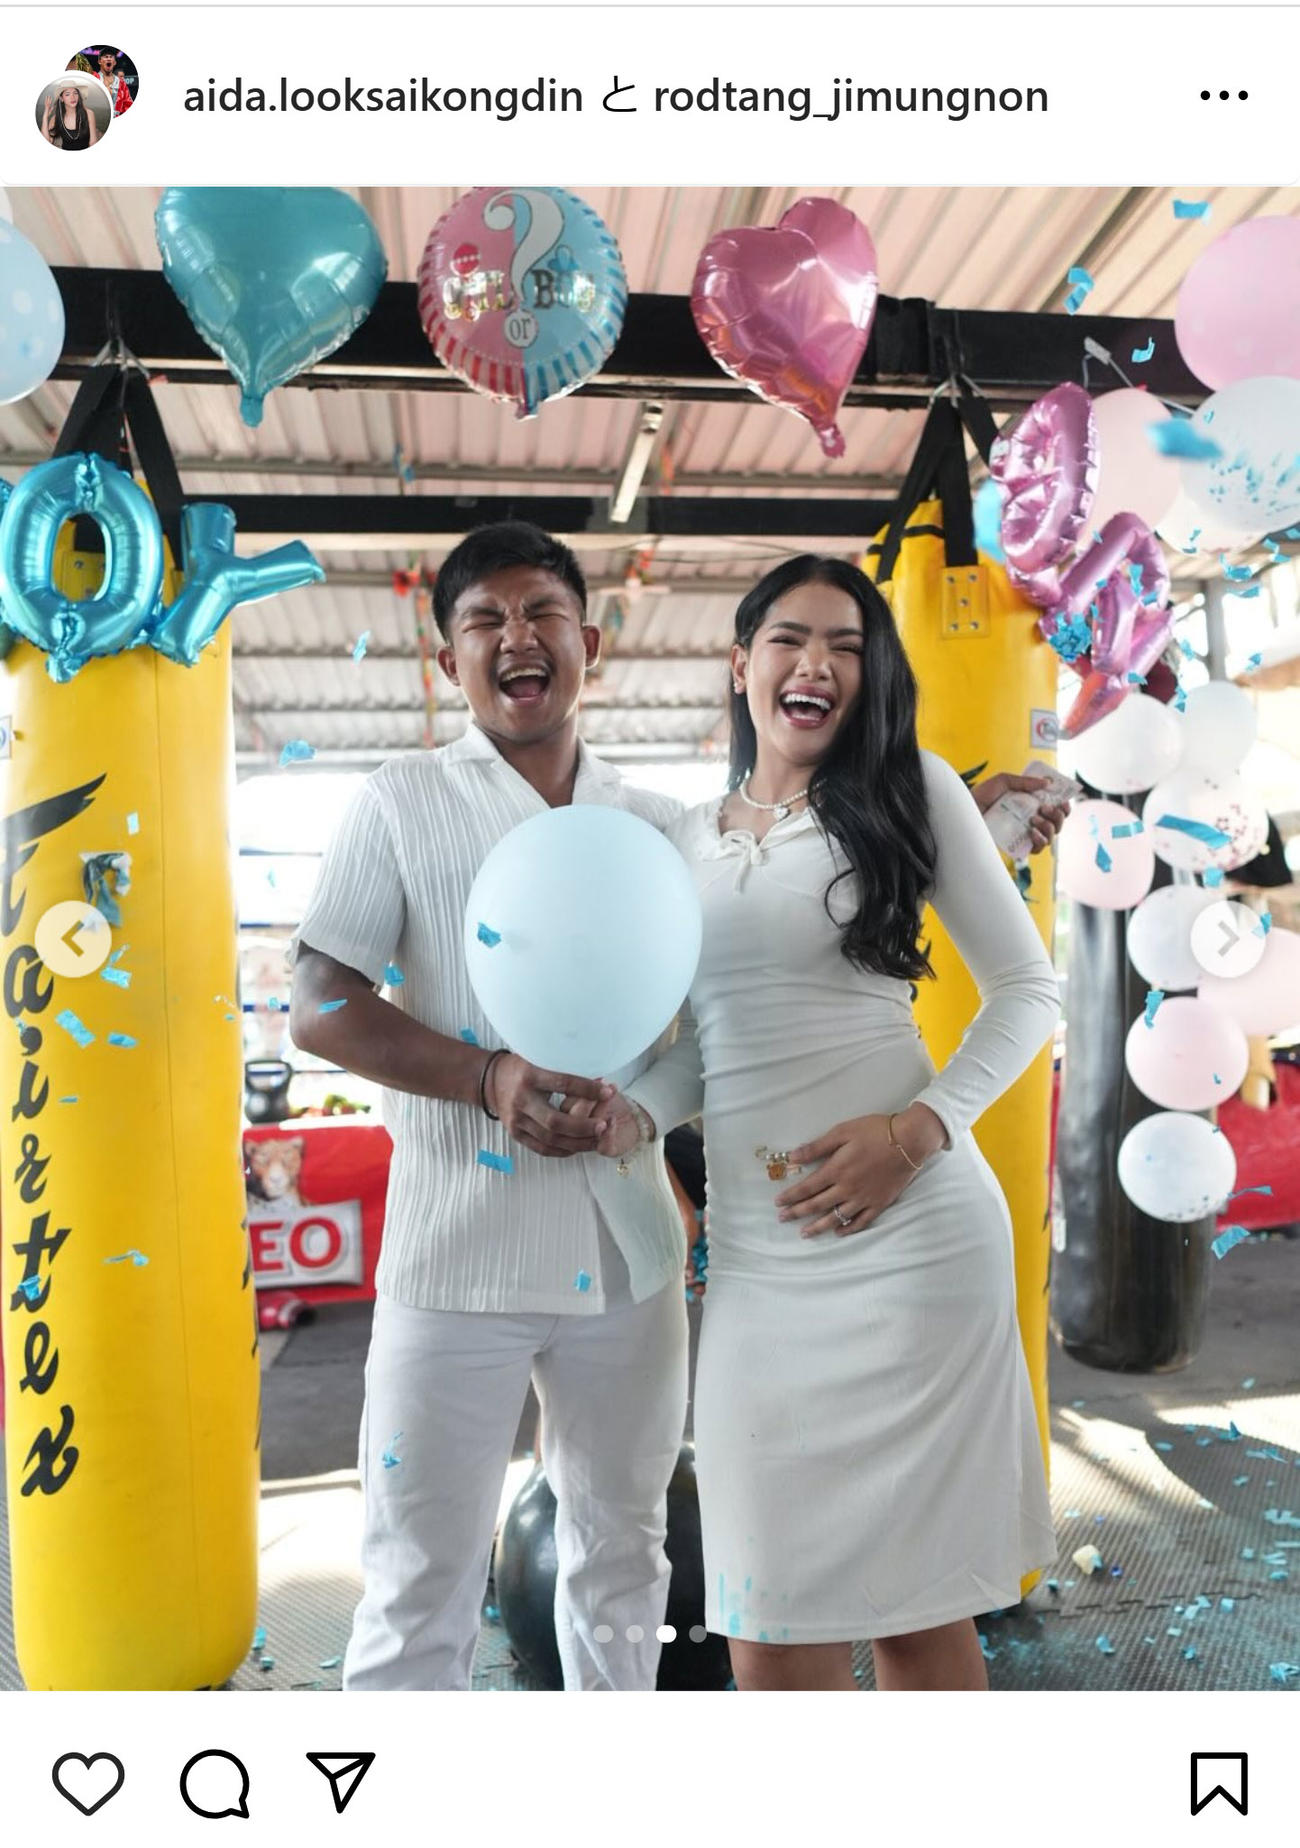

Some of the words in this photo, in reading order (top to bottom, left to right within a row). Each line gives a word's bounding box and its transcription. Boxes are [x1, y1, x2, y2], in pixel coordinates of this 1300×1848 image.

[509, 318, 530, 339] or
[0, 451, 326, 683] OY
[249, 1217, 341, 1272] EO
